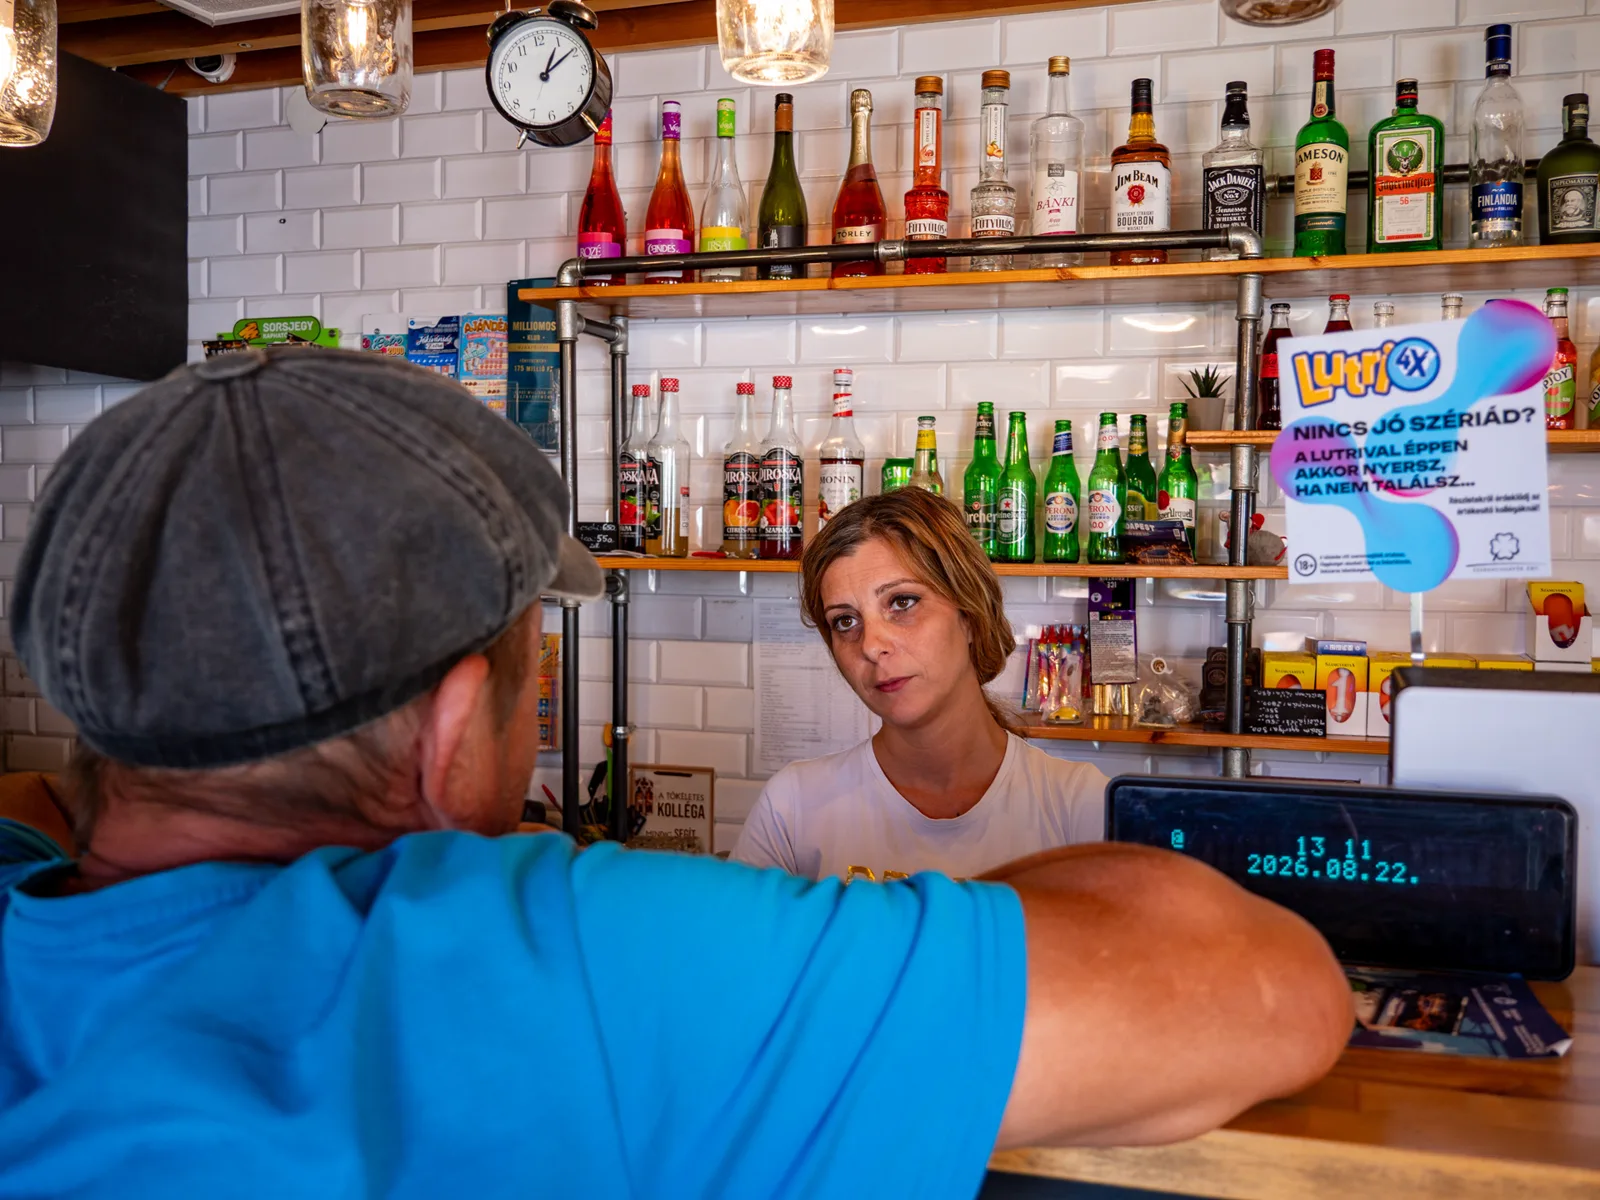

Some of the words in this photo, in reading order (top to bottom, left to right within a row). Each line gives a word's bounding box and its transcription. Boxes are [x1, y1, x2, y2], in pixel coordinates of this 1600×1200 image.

[534, 35, 545, 47] 12
[556, 36, 561, 47] 1
[518, 45, 527, 56] 11
[571, 47, 579, 58] 2
[507, 61, 518, 73] 10
[580, 64, 588, 76] 3
[503, 81, 512, 92] 9
[577, 84, 585, 95] 4
[512, 98, 521, 109] 8
[567, 101, 574, 113] 5
[529, 108, 537, 119] 7
[548, 110, 556, 121] 6
[1115, 174, 1132, 191] JIM
[1133, 169, 1160, 190] BEAM
[1208, 177, 1227, 193] JACK
[1226, 172, 1257, 190] DANIEL'S
[1036, 196, 1075, 211] BÁNKI
[1399, 196, 1410, 205] 56
[1477, 193, 1518, 208] FINLANDIA
[1117, 216, 1154, 227] BOURBON
[837, 229, 872, 238] TÖRLEY
[580, 243, 602, 258] ROZÉ
[263, 320, 314, 332] SORSJEGY
[512, 321, 556, 331] MILLIOMOS
[1292, 340, 1391, 408] Lutri
[1395, 346, 1429, 378] 4X
[1543, 367, 1569, 390] PJOY
[976, 420, 993, 428] reher
[1293, 421, 1368, 441] NINCS
[1372, 414, 1405, 435] JÓ
[1409, 403, 1537, 433] SZÉRIÁD?
[1294, 452, 1308, 463] A
[1310, 444, 1401, 462] LUTRIVAL
[1404, 438, 1468, 456] ÉPPEN
[1294, 465, 1359, 481] AKKOR
[1363, 458, 1446, 476] NYERSZ,
[620, 469, 647, 486] OSKA
[724, 470, 759, 486] IROSK
[820, 475, 856, 485] MONIN
[1295, 483, 1326, 496] HA
[1326, 479, 1369, 495] NEM
[1372, 474, 1476, 492] TALÁLSZ...
[1045, 507, 1075, 515] PERONI
[1127, 504, 1144, 512] sser
[1125, 522, 1155, 532] DAPEST
[1299, 560, 1314, 571] 18+
[657, 801, 705, 819] KOLLÉGA
[674, 827, 696, 838] SEGÍT
[1171, 829, 1185, 848] @
[1296, 836, 1326, 857] 13
[1345, 838, 1372, 860] 11
[1247, 853, 1418, 884] 2026.08.22.
